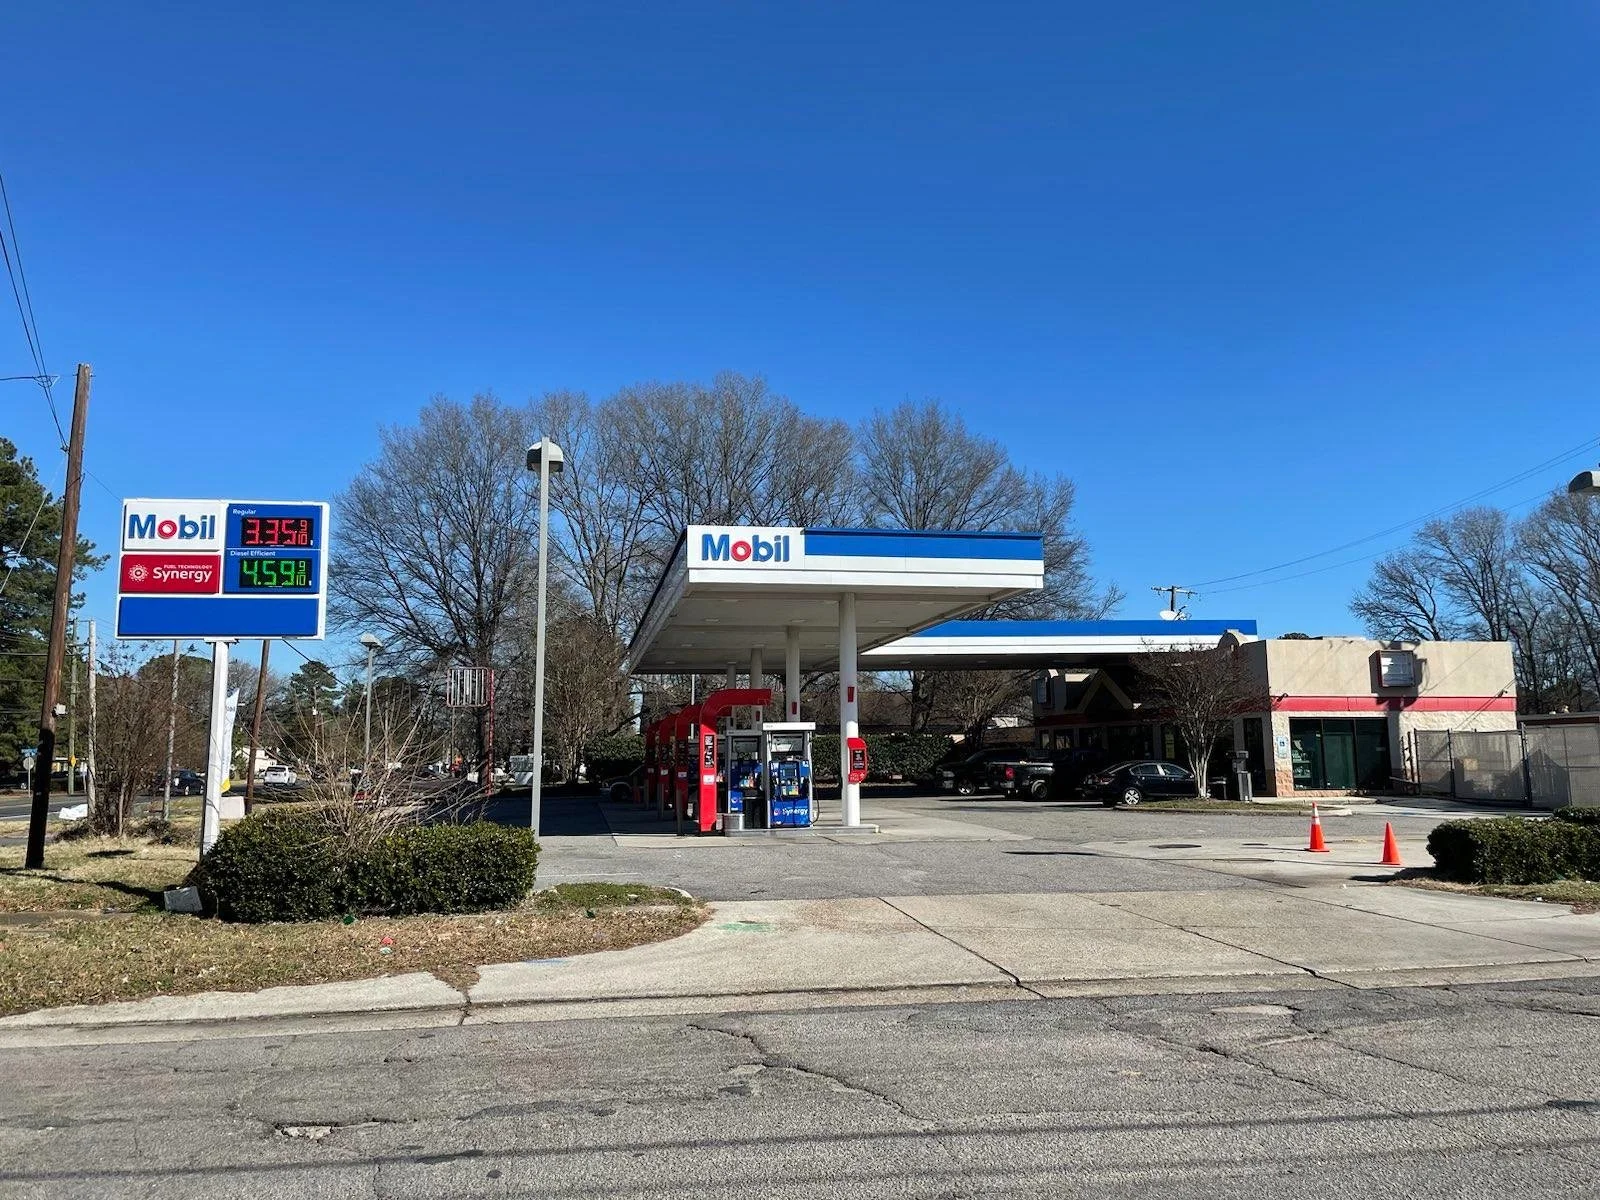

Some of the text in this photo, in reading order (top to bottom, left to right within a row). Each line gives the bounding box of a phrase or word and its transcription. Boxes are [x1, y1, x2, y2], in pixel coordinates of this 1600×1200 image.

[232, 508, 256, 516] Regular
[128, 514, 215, 539] Mobil
[245, 519, 296, 545] 3.35
[702, 534, 789, 562] Mobil
[152, 566, 212, 583] Synergy
[242, 560, 295, 585] 4.59
